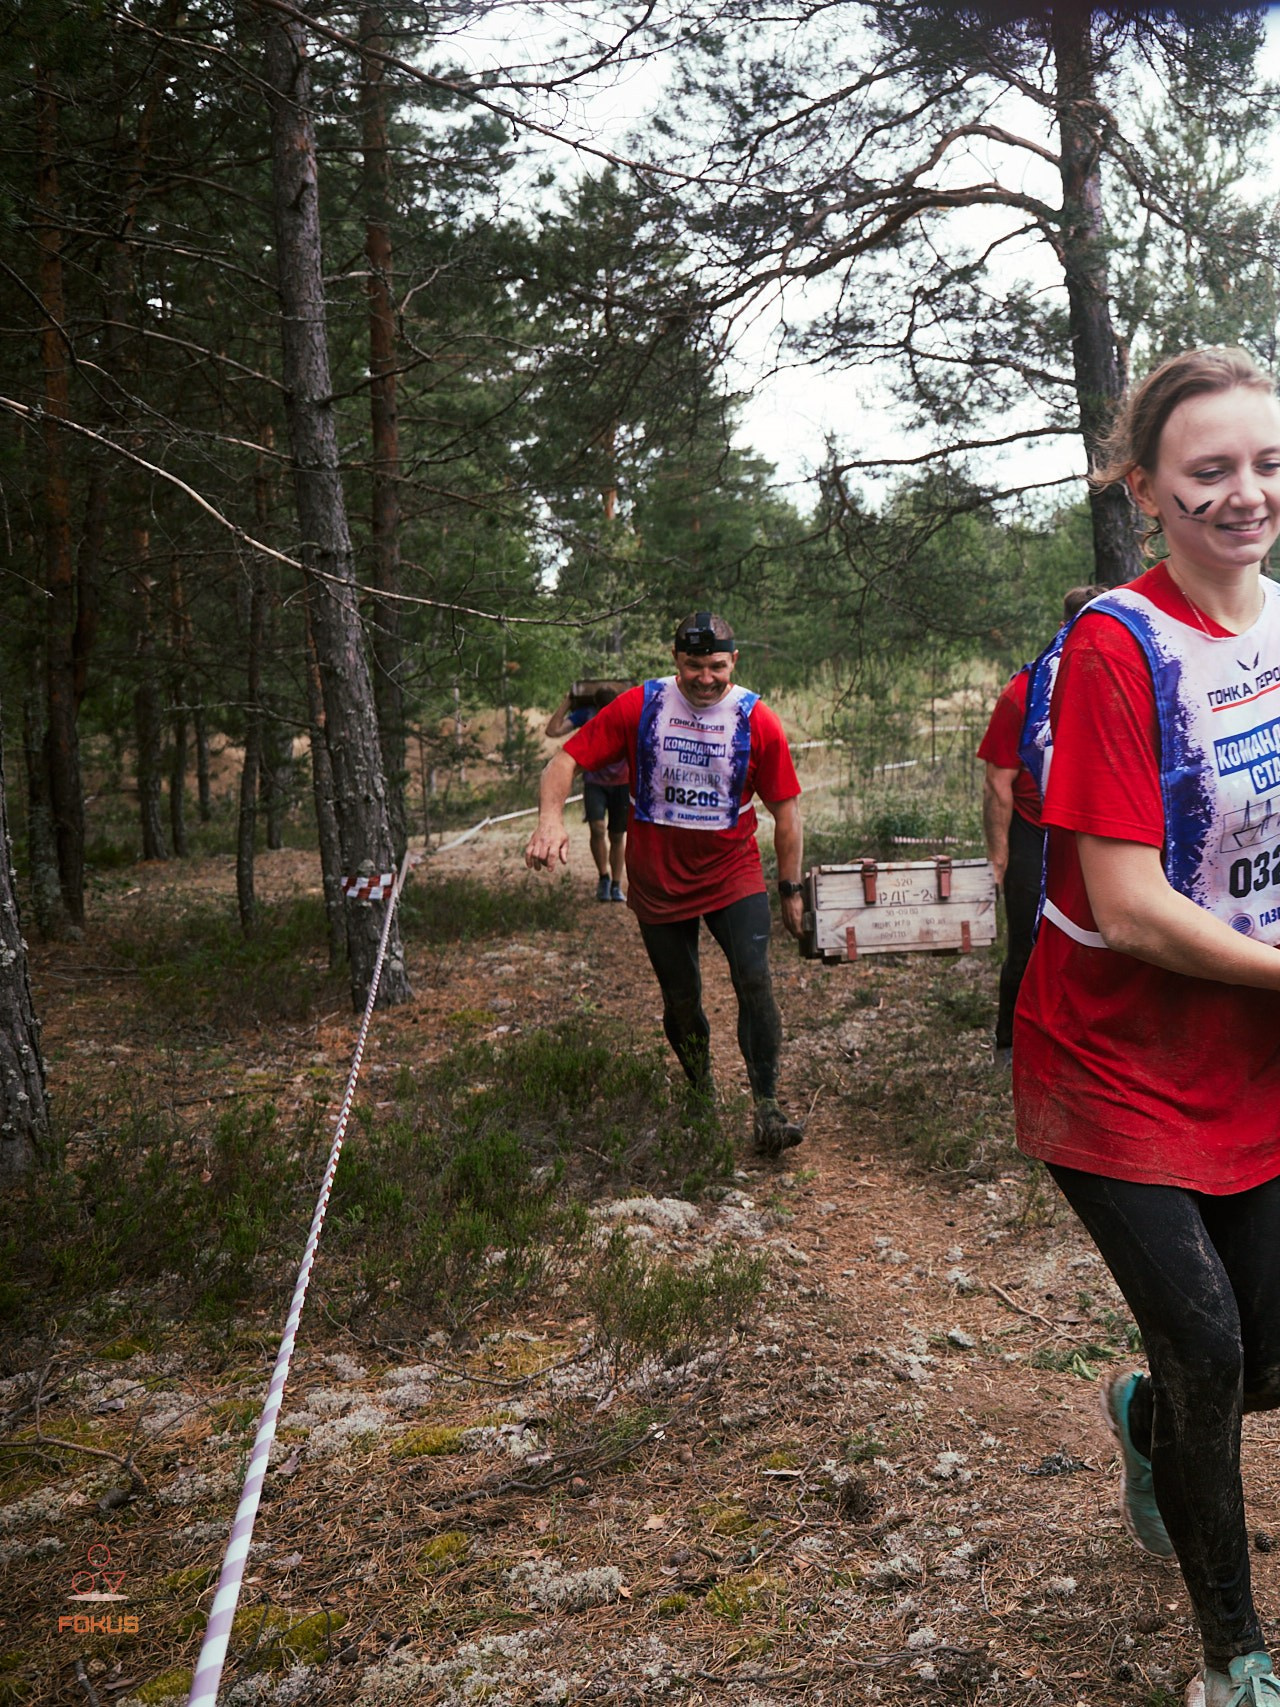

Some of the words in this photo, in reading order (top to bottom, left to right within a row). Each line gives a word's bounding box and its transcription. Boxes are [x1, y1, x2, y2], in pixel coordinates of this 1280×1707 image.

[1207, 682, 1253, 706] ГОНКА
[669, 717, 695, 729] ГОНКА
[696, 721, 725, 732] ГЕРОЕВ
[664, 738, 725, 756] КОМАНДНЫЙ
[680, 753, 708, 765] СТАРТ
[664, 786, 719, 807] 03206
[677, 812, 720, 822] ГАЗПРОМБАНК
